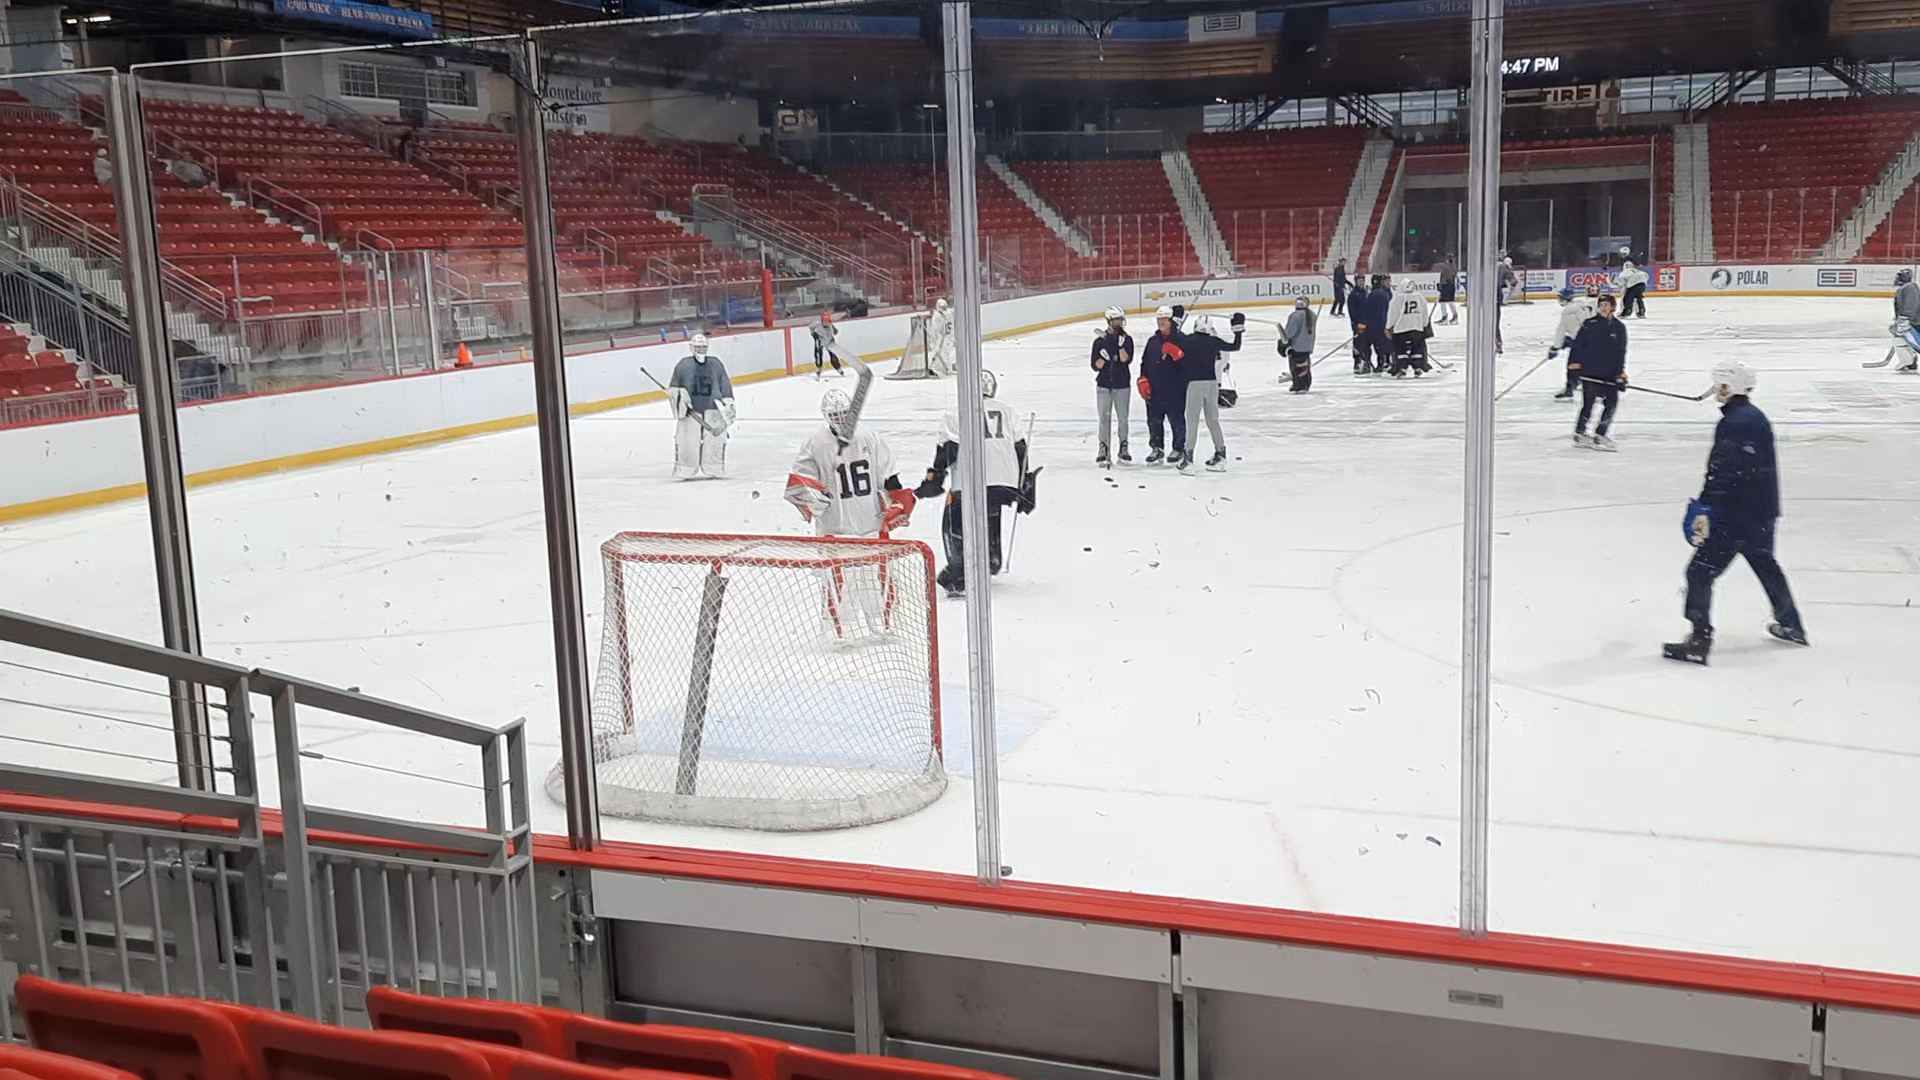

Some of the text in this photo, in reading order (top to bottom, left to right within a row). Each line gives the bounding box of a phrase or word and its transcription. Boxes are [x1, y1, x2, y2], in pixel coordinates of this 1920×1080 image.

[1440, 0, 1472, 12] MIK
[1500, 56, 1559, 75] 4:47 PM
[545, 110, 587, 125] instein
[1737, 270, 1769, 285] POLAR
[1169, 288, 1225, 298] CHEVROLET
[1403, 301, 1419, 314] 12
[836, 459, 872, 499] 16
